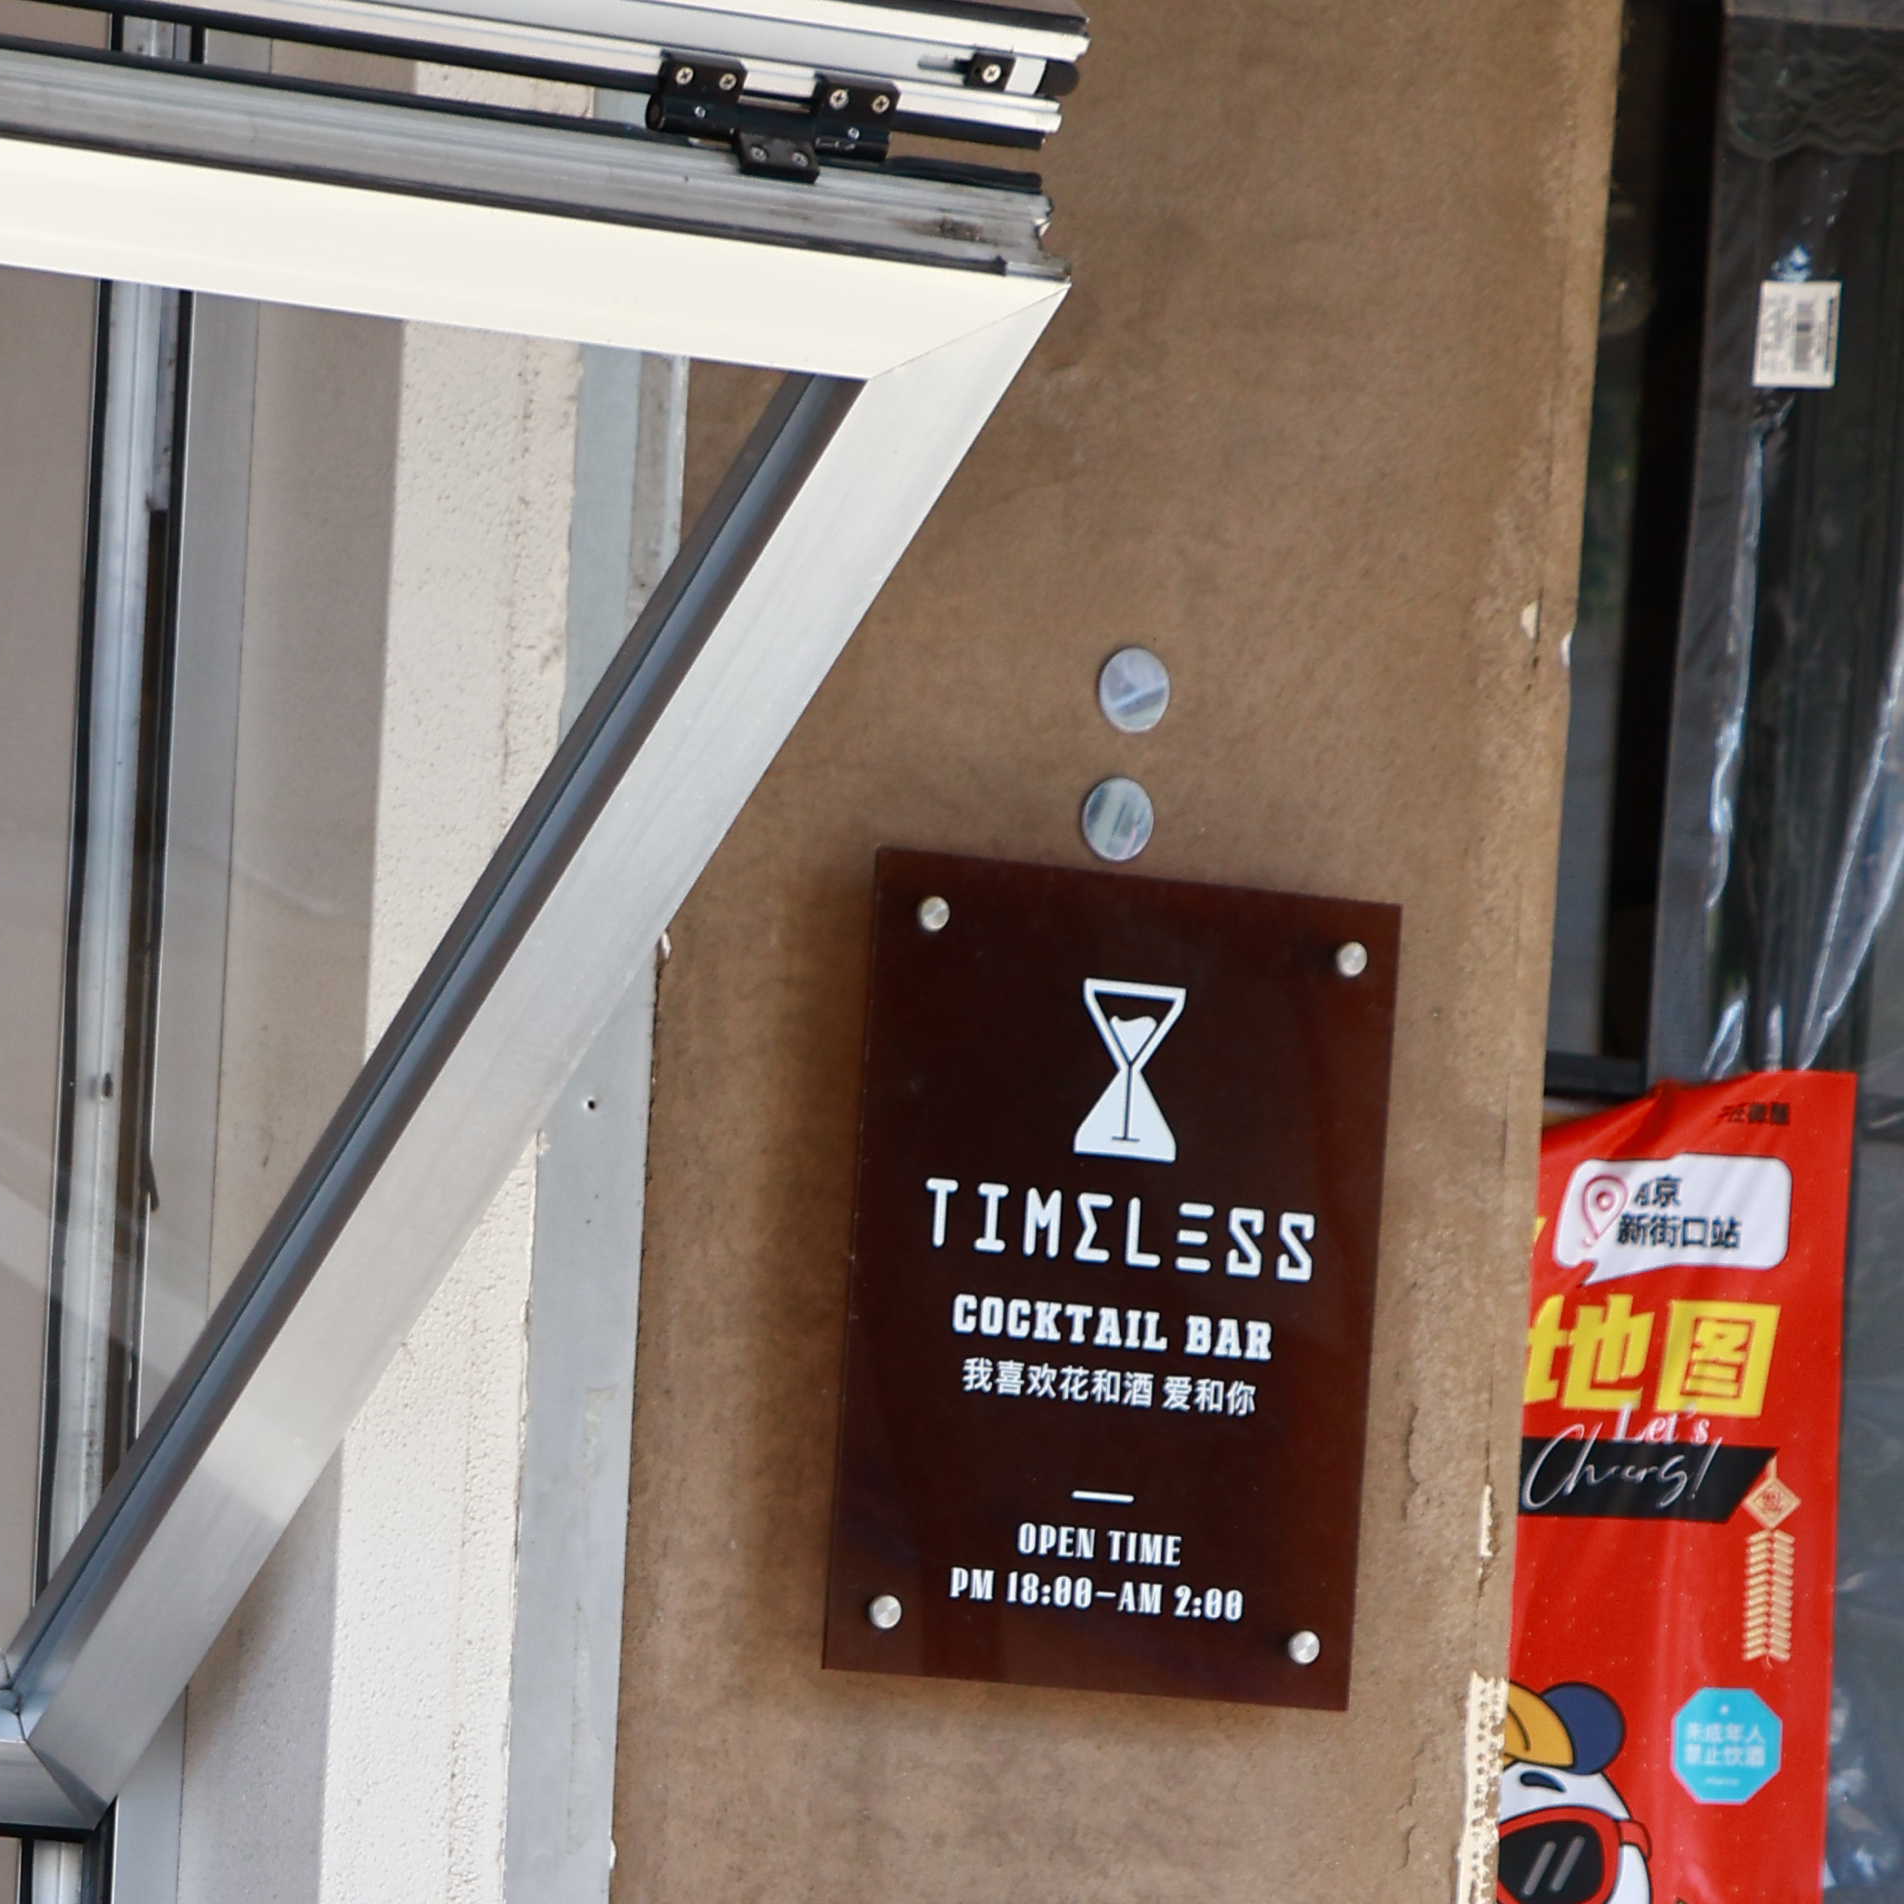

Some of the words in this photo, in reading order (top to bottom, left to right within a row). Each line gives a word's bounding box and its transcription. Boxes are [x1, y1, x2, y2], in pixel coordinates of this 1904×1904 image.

[925, 1177, 1316, 1282] TIMELESS
[1616, 1212, 1742, 1249] 新街口站
[952, 1293, 1168, 1352] COCKTAIL
[1184, 1315, 1272, 1361] BAR
[1523, 1293, 1781, 1418] 地图
[961, 1356, 1154, 1409] 我喜欢花和酒
[1162, 1375, 1257, 1417] 爱和你
[1613, 1400, 1711, 1445] Let's
[1017, 1522, 1096, 1559] OPEN
[1107, 1530, 1183, 1567] TIME
[949, 1566, 995, 1600] PM
[1173, 1584, 1244, 1622] 2:00
